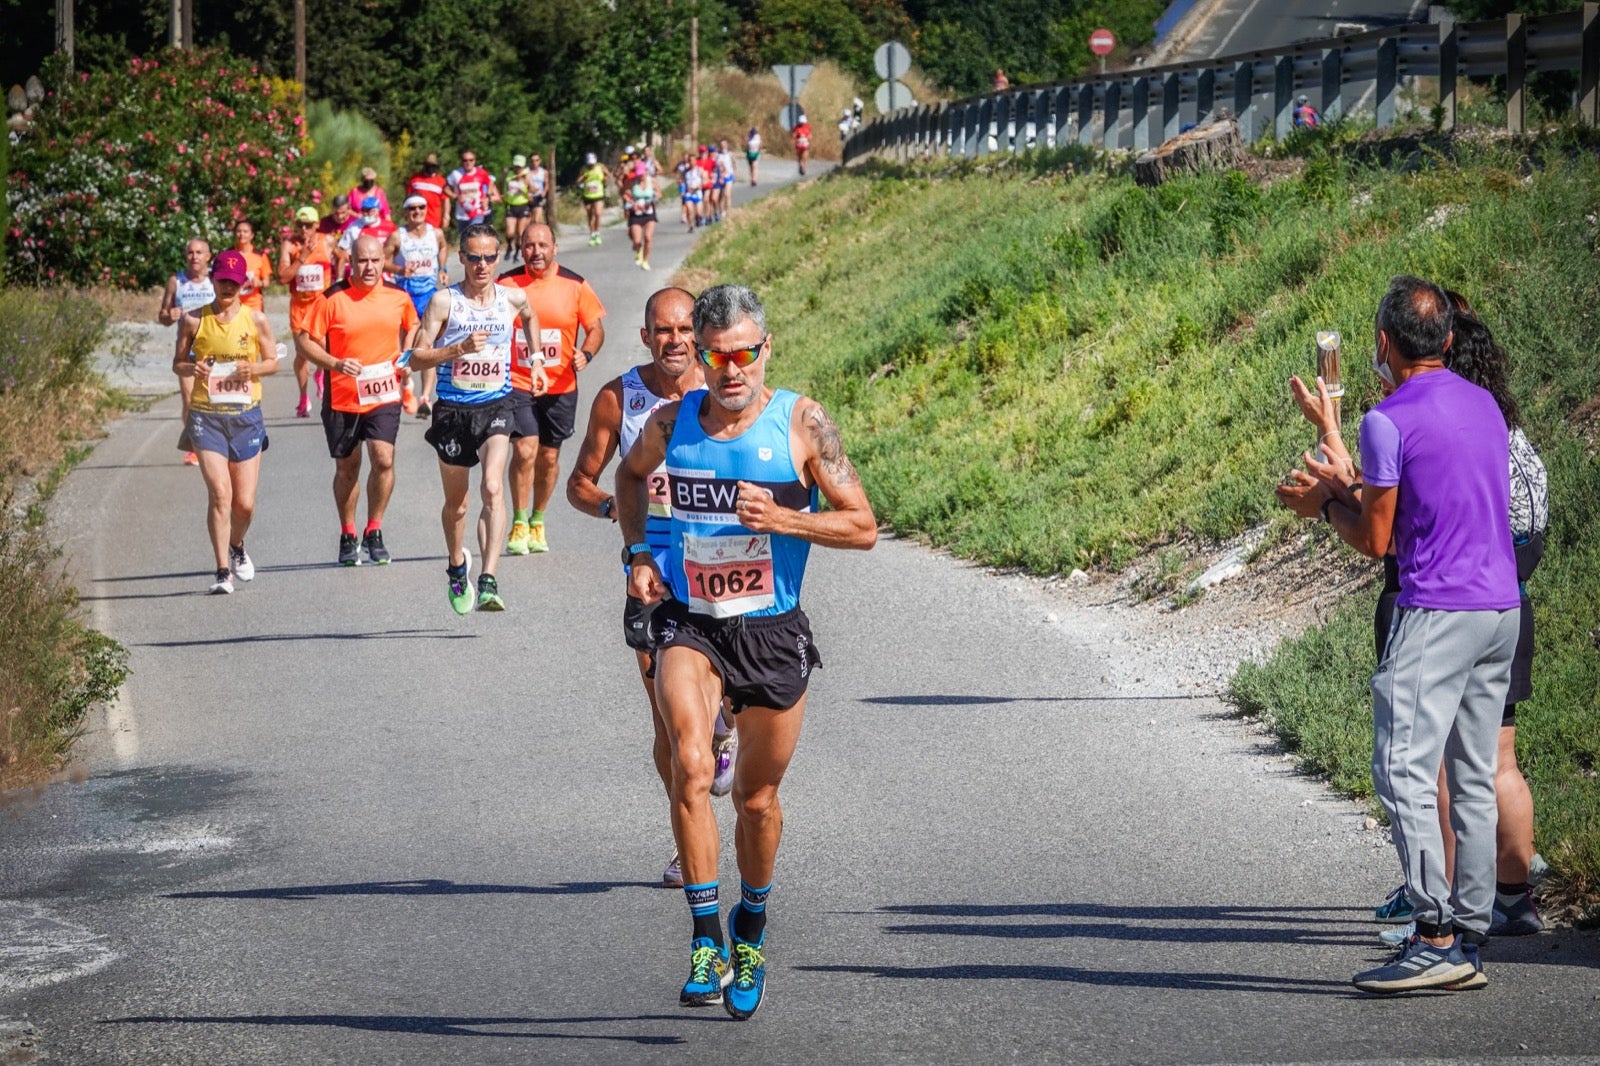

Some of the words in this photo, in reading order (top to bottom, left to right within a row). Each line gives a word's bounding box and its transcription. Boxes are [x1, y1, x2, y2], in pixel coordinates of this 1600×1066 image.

[300, 274, 320, 283] 2128
[457, 323, 505, 332] MARACENA
[522, 346, 557, 359] 110
[461, 362, 500, 376] 2084
[216, 380, 249, 393] 1076
[364, 378, 394, 395] 1011
[676, 482, 774, 508] BEW
[696, 569, 764, 598] 1062
